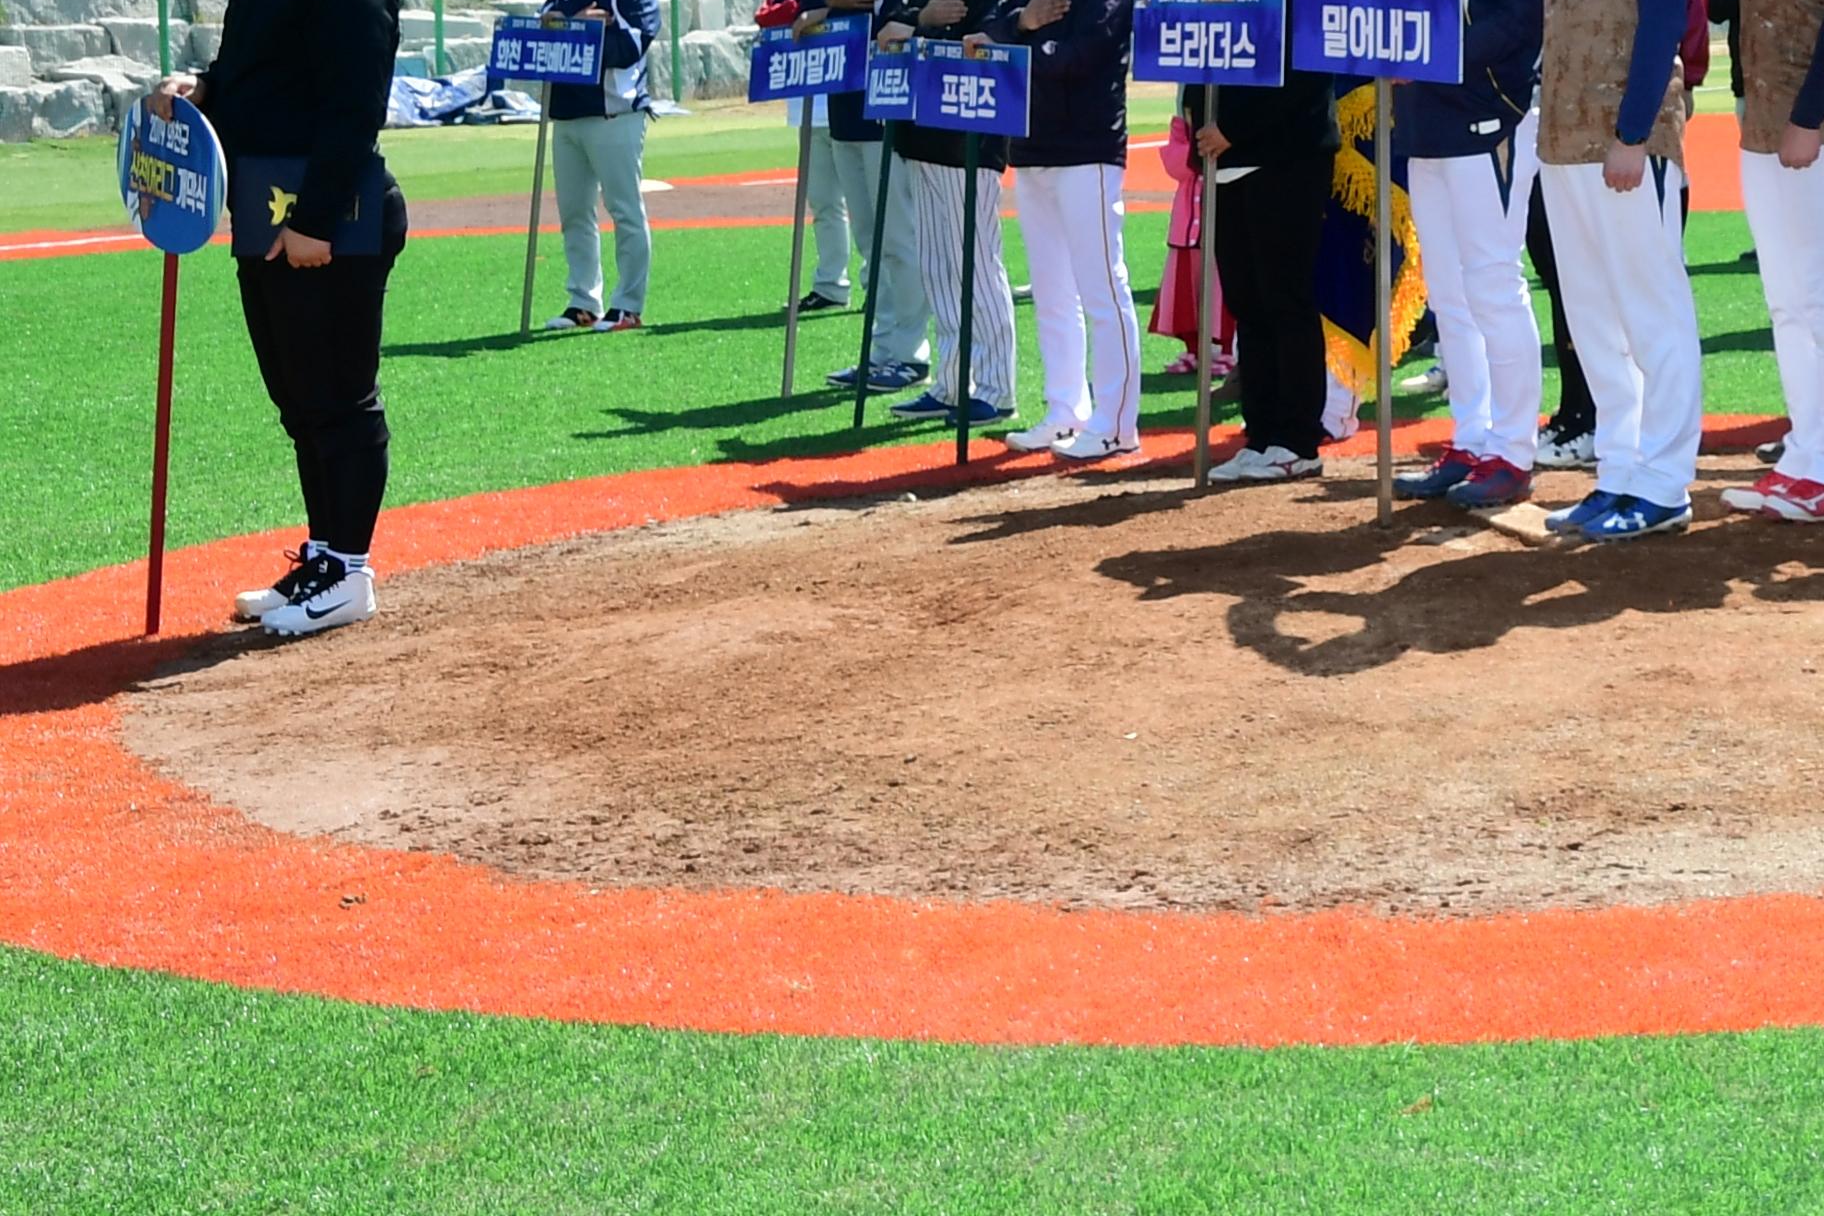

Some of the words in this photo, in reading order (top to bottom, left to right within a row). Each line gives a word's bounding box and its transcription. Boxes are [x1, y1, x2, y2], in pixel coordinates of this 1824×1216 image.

[495, 38, 522, 71] 화천
[1157, 21, 1256, 70] 브라더스
[1322, 4, 1431, 65] 밀어내기
[768, 44, 846, 90] 칠까말까
[940, 73, 996, 119] 프렌즈
